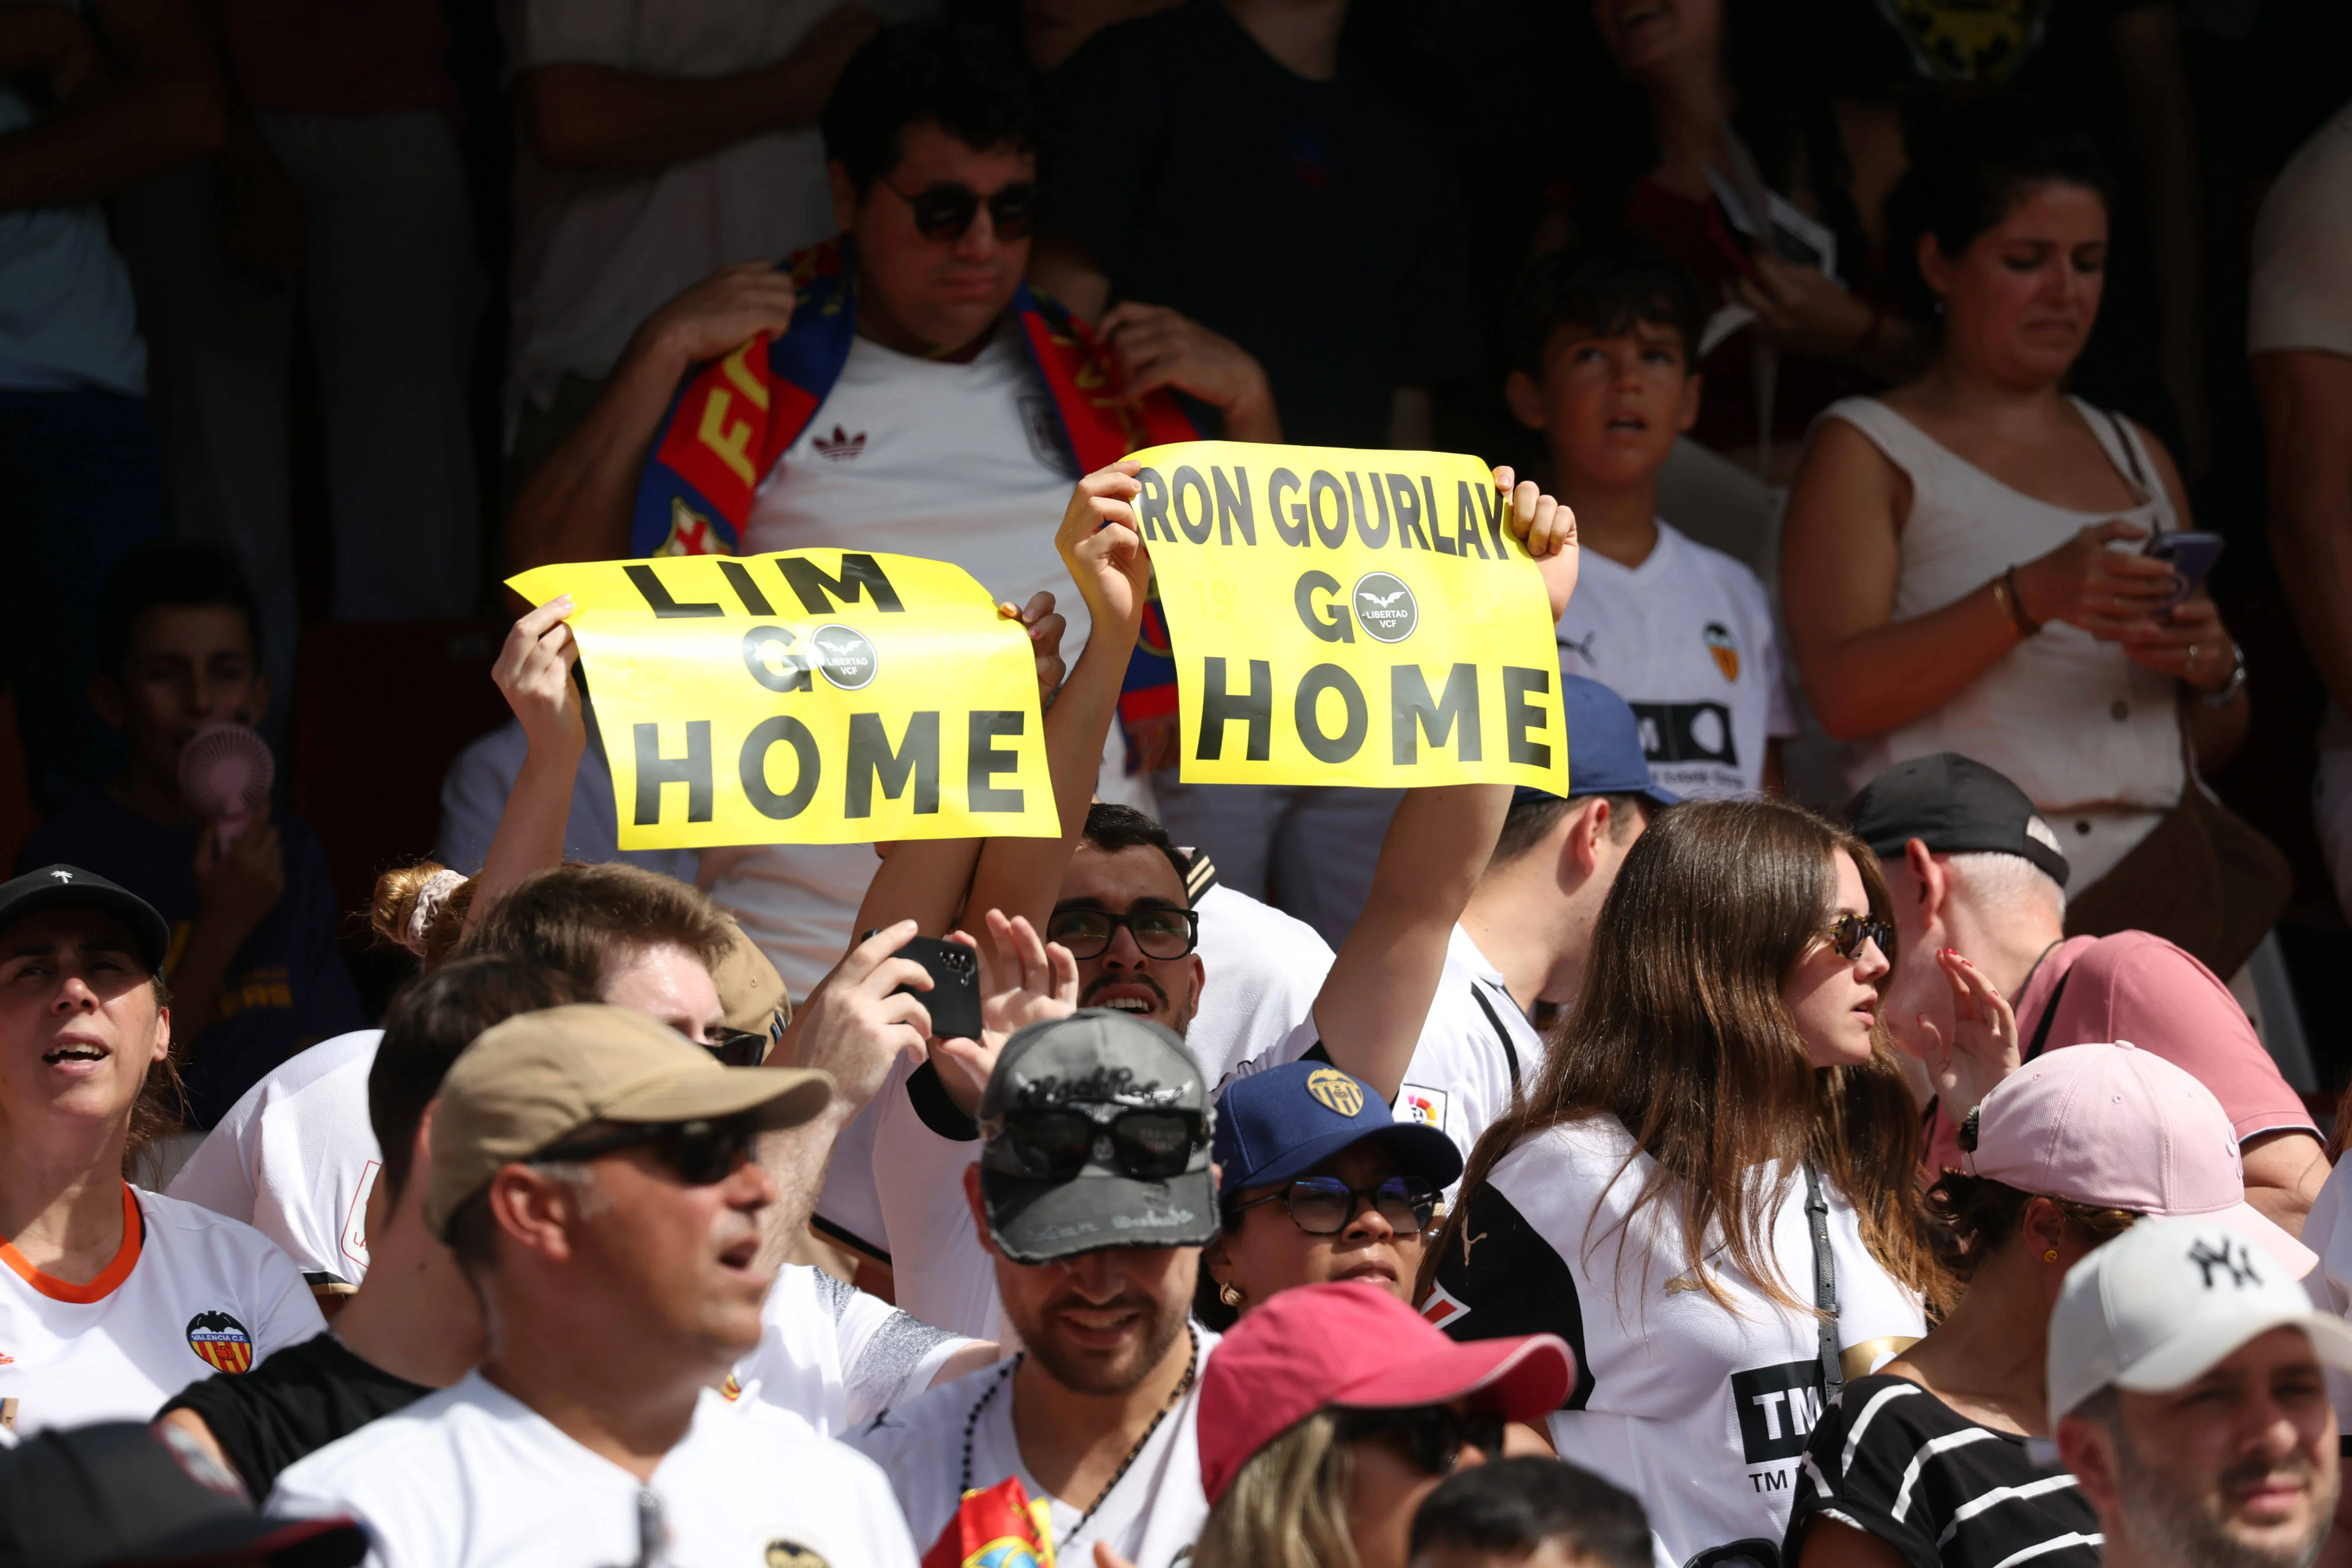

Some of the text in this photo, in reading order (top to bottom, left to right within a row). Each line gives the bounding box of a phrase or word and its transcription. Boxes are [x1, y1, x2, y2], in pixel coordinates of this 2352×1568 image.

[1135, 465, 1509, 560] RON GOURLAY
[622, 554, 906, 619] LIM
[1366, 610, 1408, 619] LIBERTAD
[1379, 620, 1397, 628] VCF
[826, 657, 869, 666] LIBERTAD
[840, 666, 858, 676] VCF
[1195, 656, 1551, 770] HOME
[633, 711, 1025, 826] HOME
[1752, 1386, 1823, 1440] TM
[1748, 1469, 1788, 1493] TM
